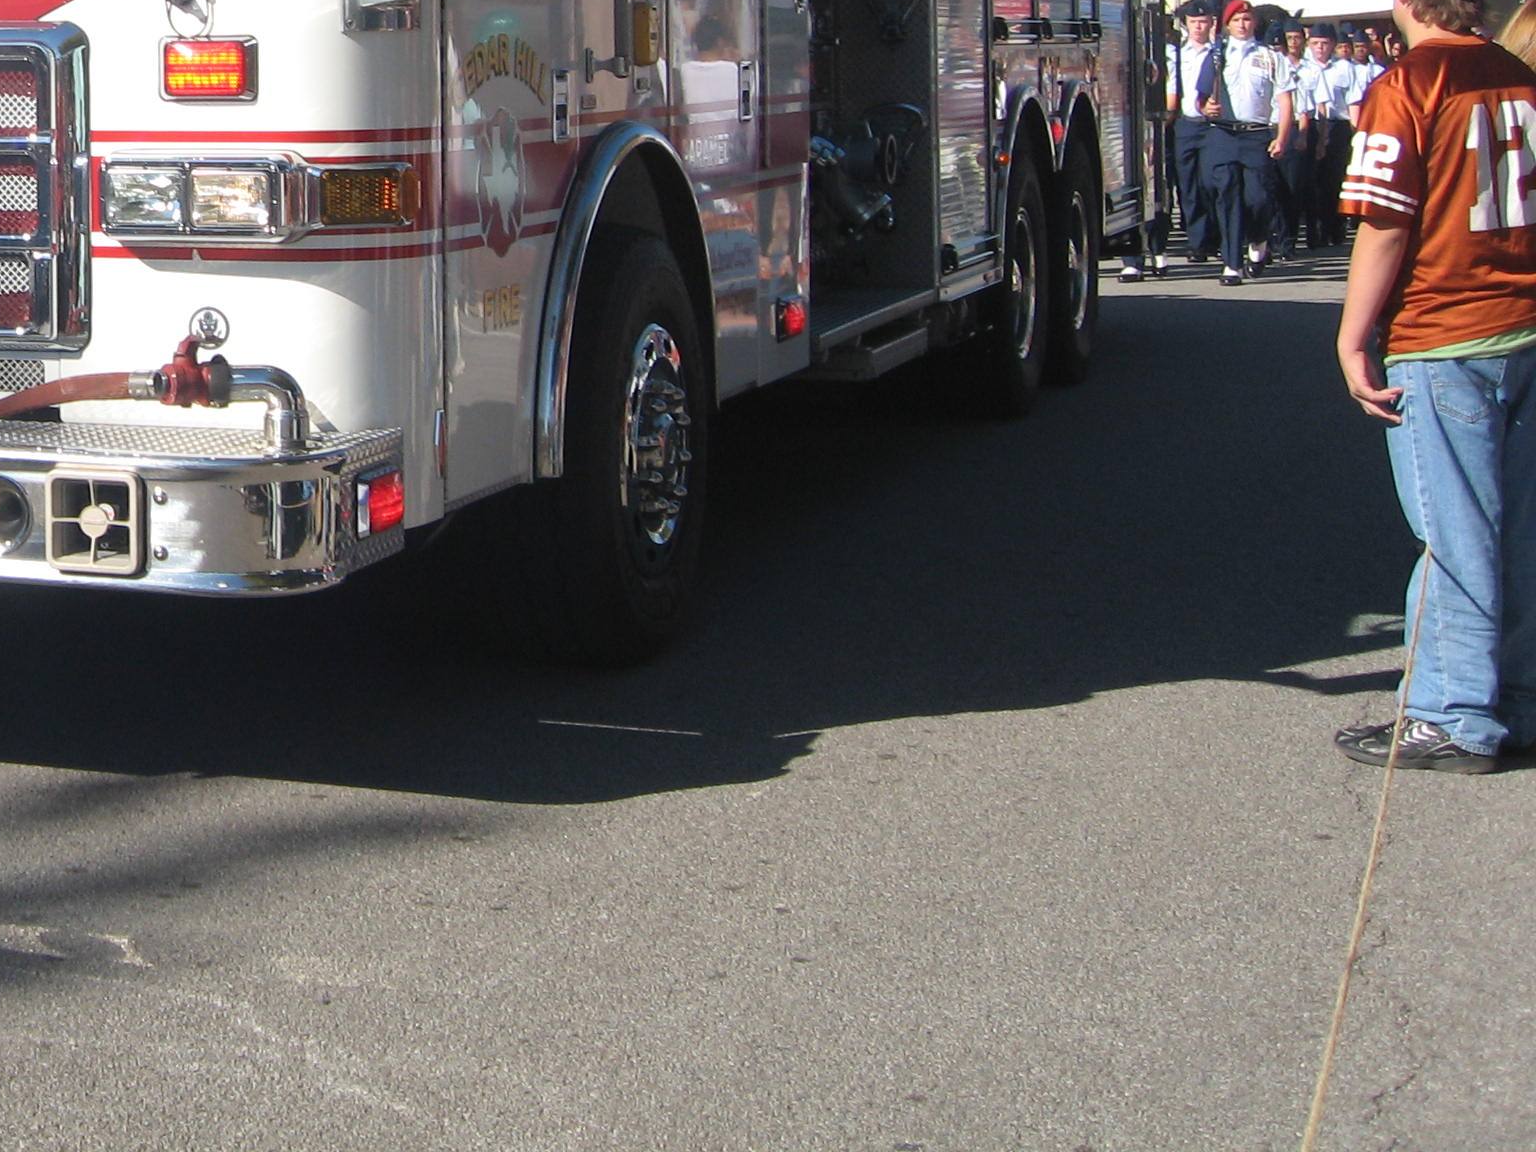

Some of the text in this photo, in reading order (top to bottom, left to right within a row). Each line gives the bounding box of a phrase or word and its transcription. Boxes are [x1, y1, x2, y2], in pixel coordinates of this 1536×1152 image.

[461, 33, 547, 106] EDAR HILL
[1346, 130, 1401, 183] 12
[482, 284, 521, 334] FIRE
